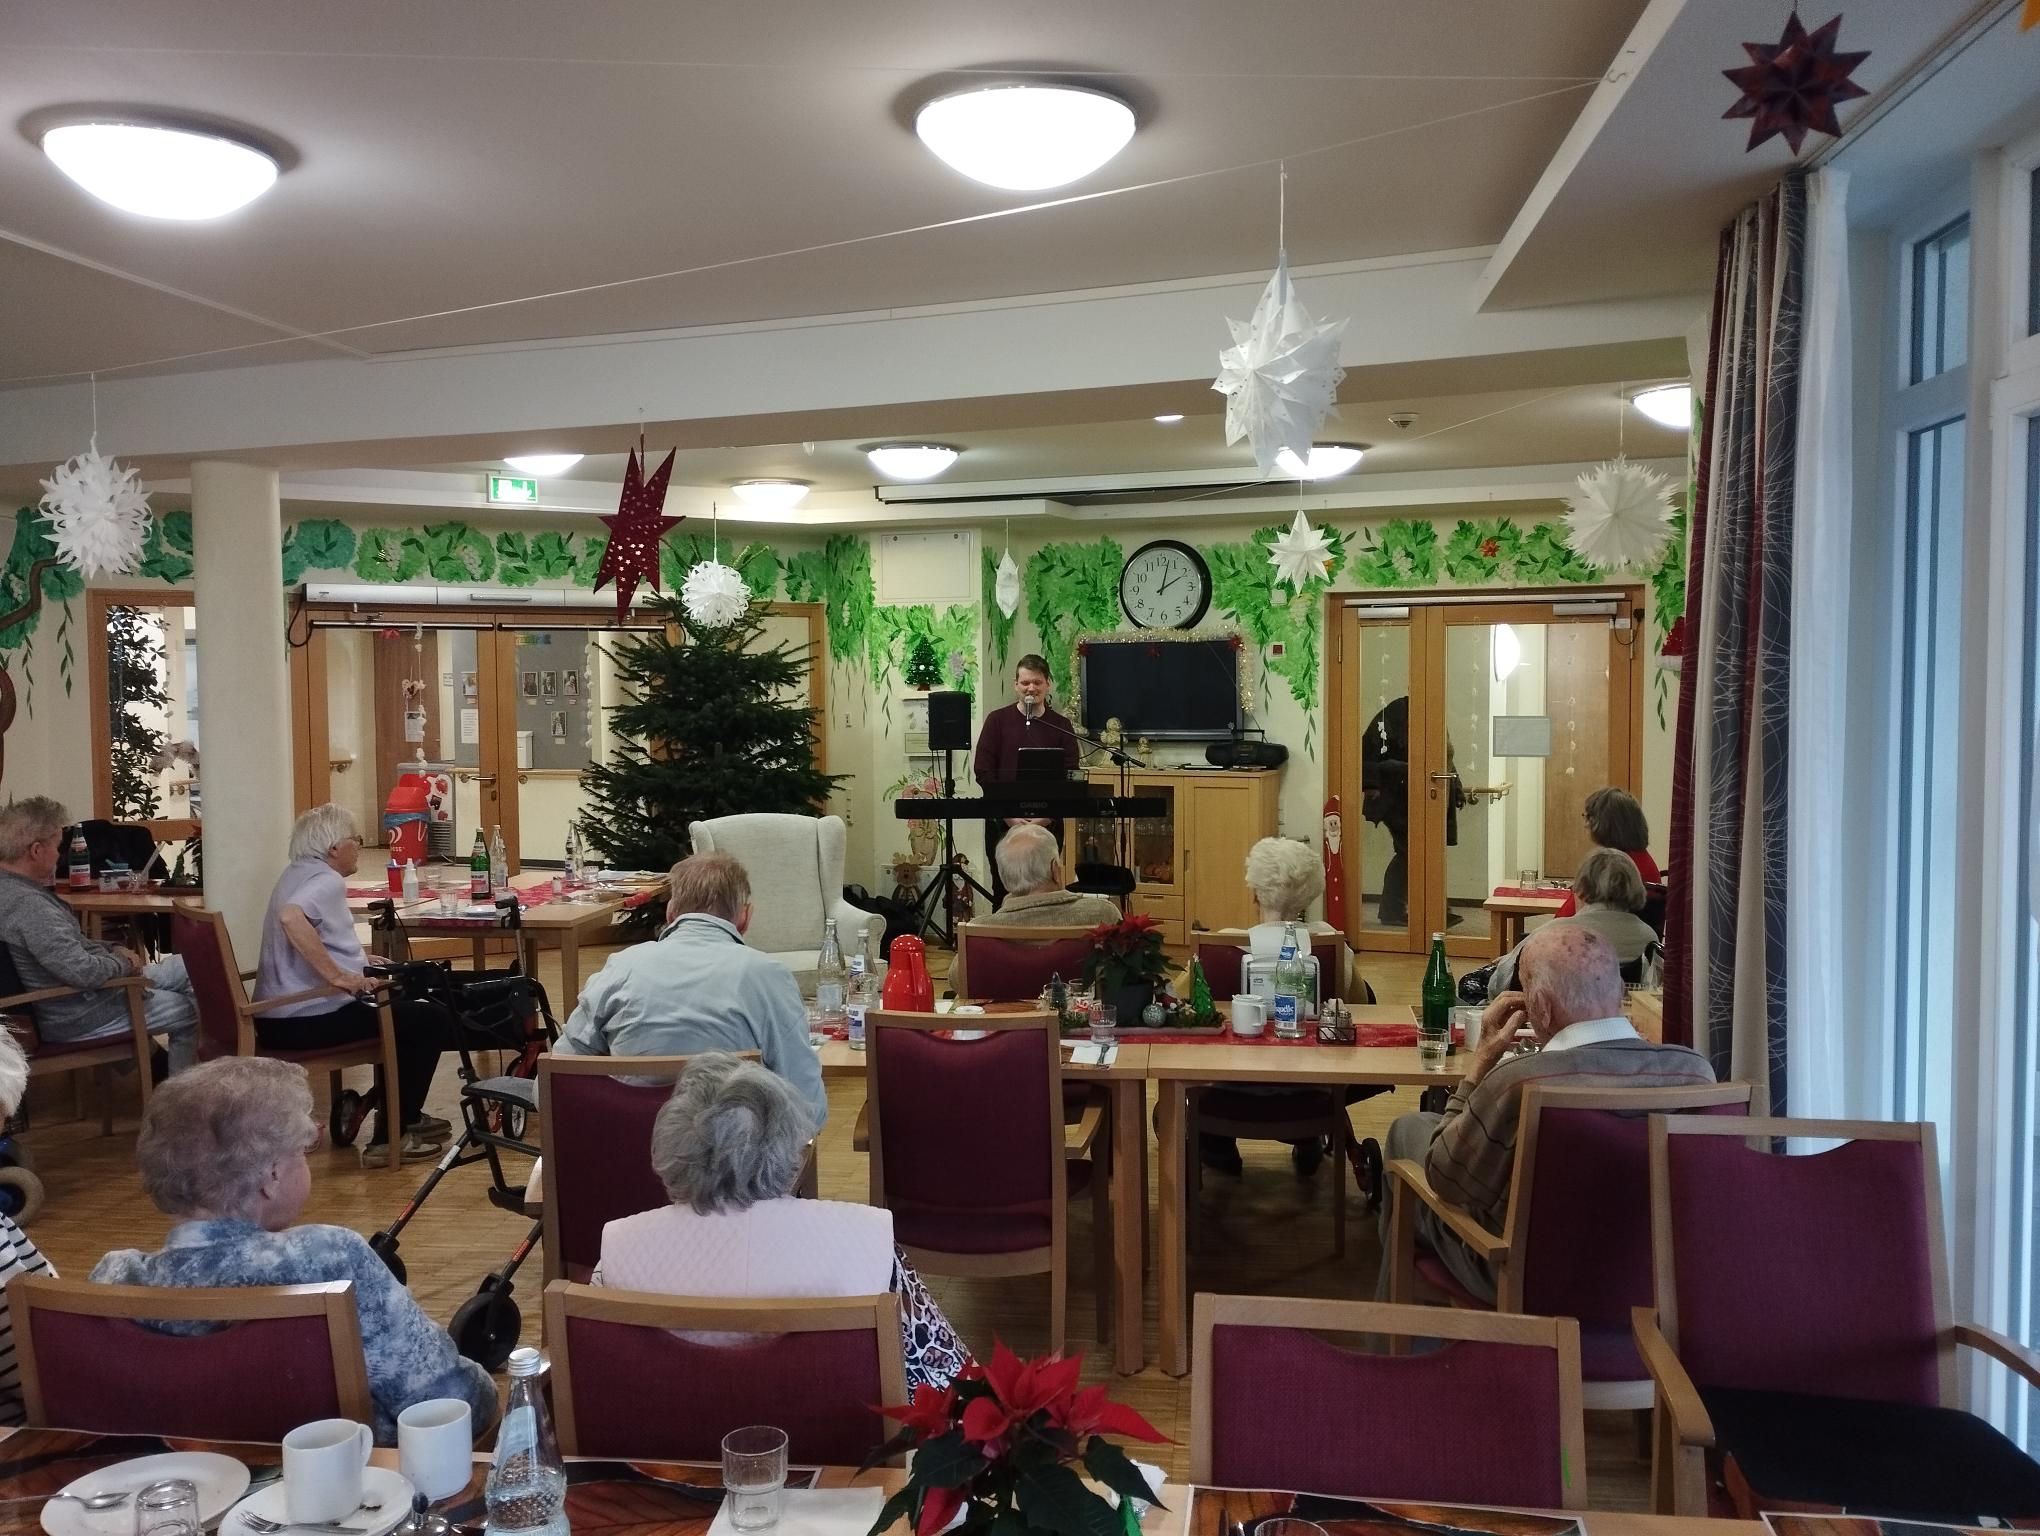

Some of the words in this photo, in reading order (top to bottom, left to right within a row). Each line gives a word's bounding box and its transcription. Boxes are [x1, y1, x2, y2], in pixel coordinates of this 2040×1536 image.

[1156, 556, 1167, 566] 12
[1146, 562, 1154, 572] 11
[1182, 567, 1188, 577] 2
[1137, 573, 1147, 583] 10
[1132, 586, 1140, 595] 9
[1187, 581, 1194, 592] 3
[1137, 599, 1144, 609] 8
[1183, 596, 1189, 605] 4
[1148, 607, 1155, 617] 7
[1161, 611, 1168, 621] 6
[1175, 606, 1182, 617] 5
[1019, 801, 1049, 809] CASIO
